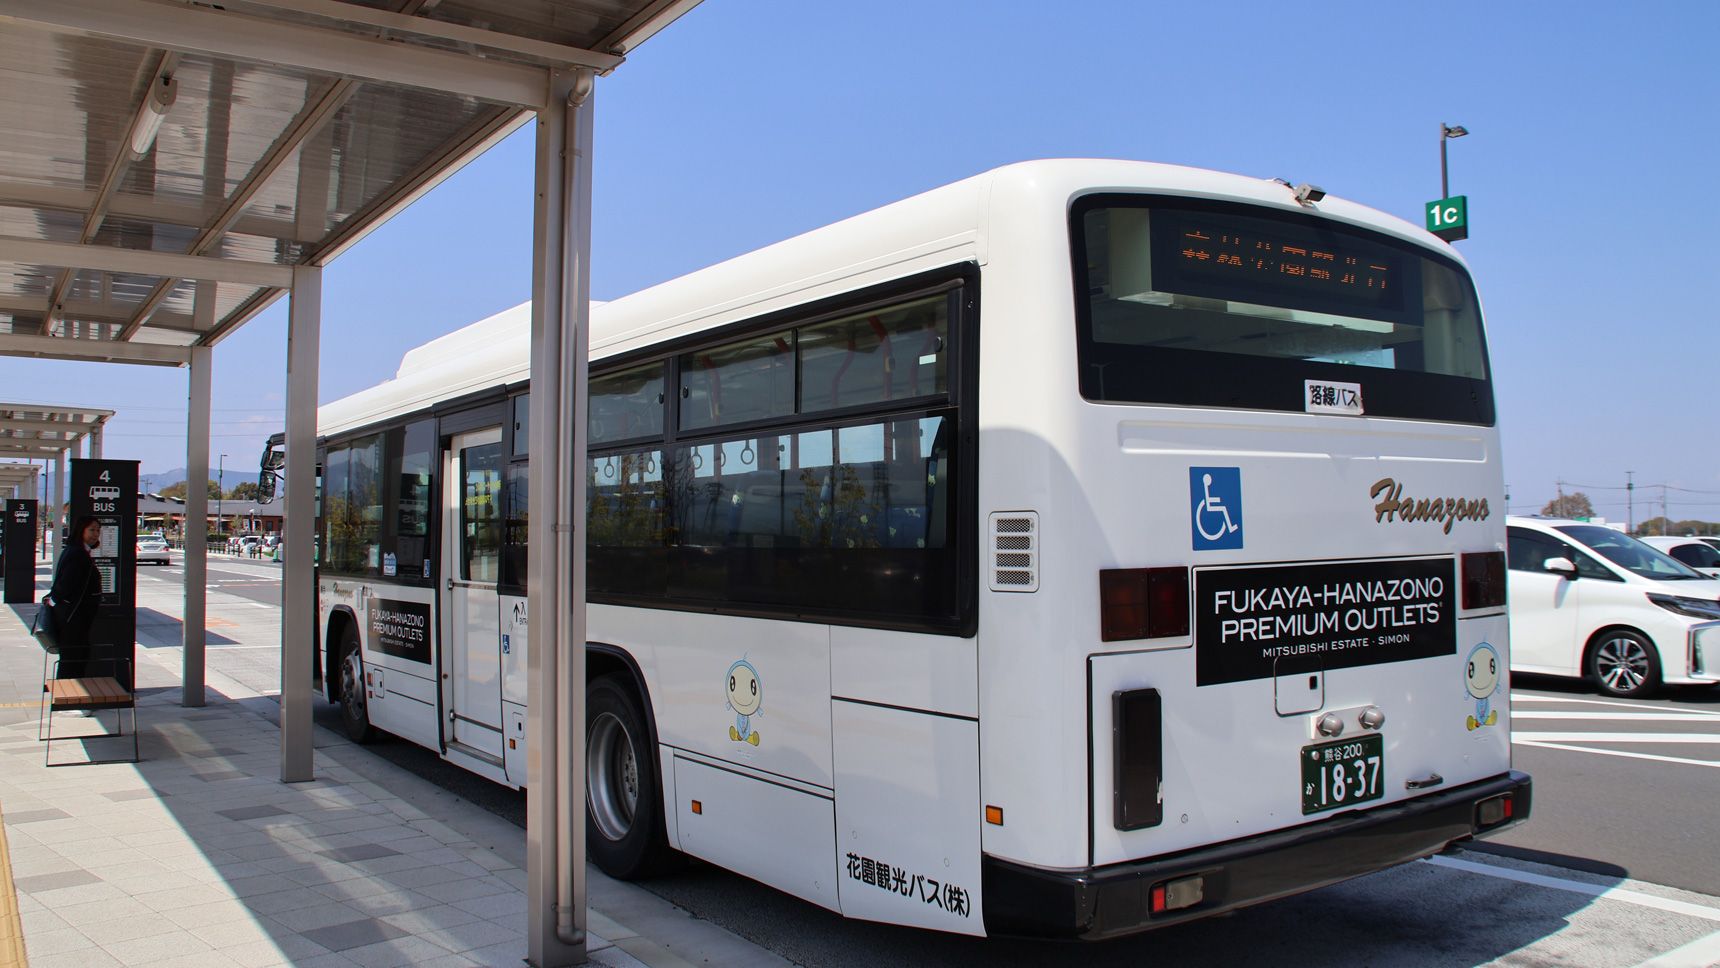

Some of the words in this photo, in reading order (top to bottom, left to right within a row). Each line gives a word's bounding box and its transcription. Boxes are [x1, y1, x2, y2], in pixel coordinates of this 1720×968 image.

[1430, 204, 1458, 226] 1c
[1309, 385, 1358, 407] 路線バス
[99, 470, 111, 483] 4
[93, 502, 115, 512] BUS
[1370, 477, 1489, 534] Hanazono
[1215, 576, 1444, 614] FUKAYA-HANAZONO
[371, 609, 424, 627] FUKAYA-HANAZONO
[1222, 611, 1339, 643] PREMIUM
[373, 622, 397, 636] PREMIUM
[397, 626, 423, 642] OUTLETS
[1263, 642, 1328, 658] MITSUBISHI
[1331, 638, 1369, 650] ESTATE
[1378, 634, 1410, 645] SIMON
[1321, 756, 1380, 805] 18-37
[846, 852, 970, 918] 花園観光バス(株)
